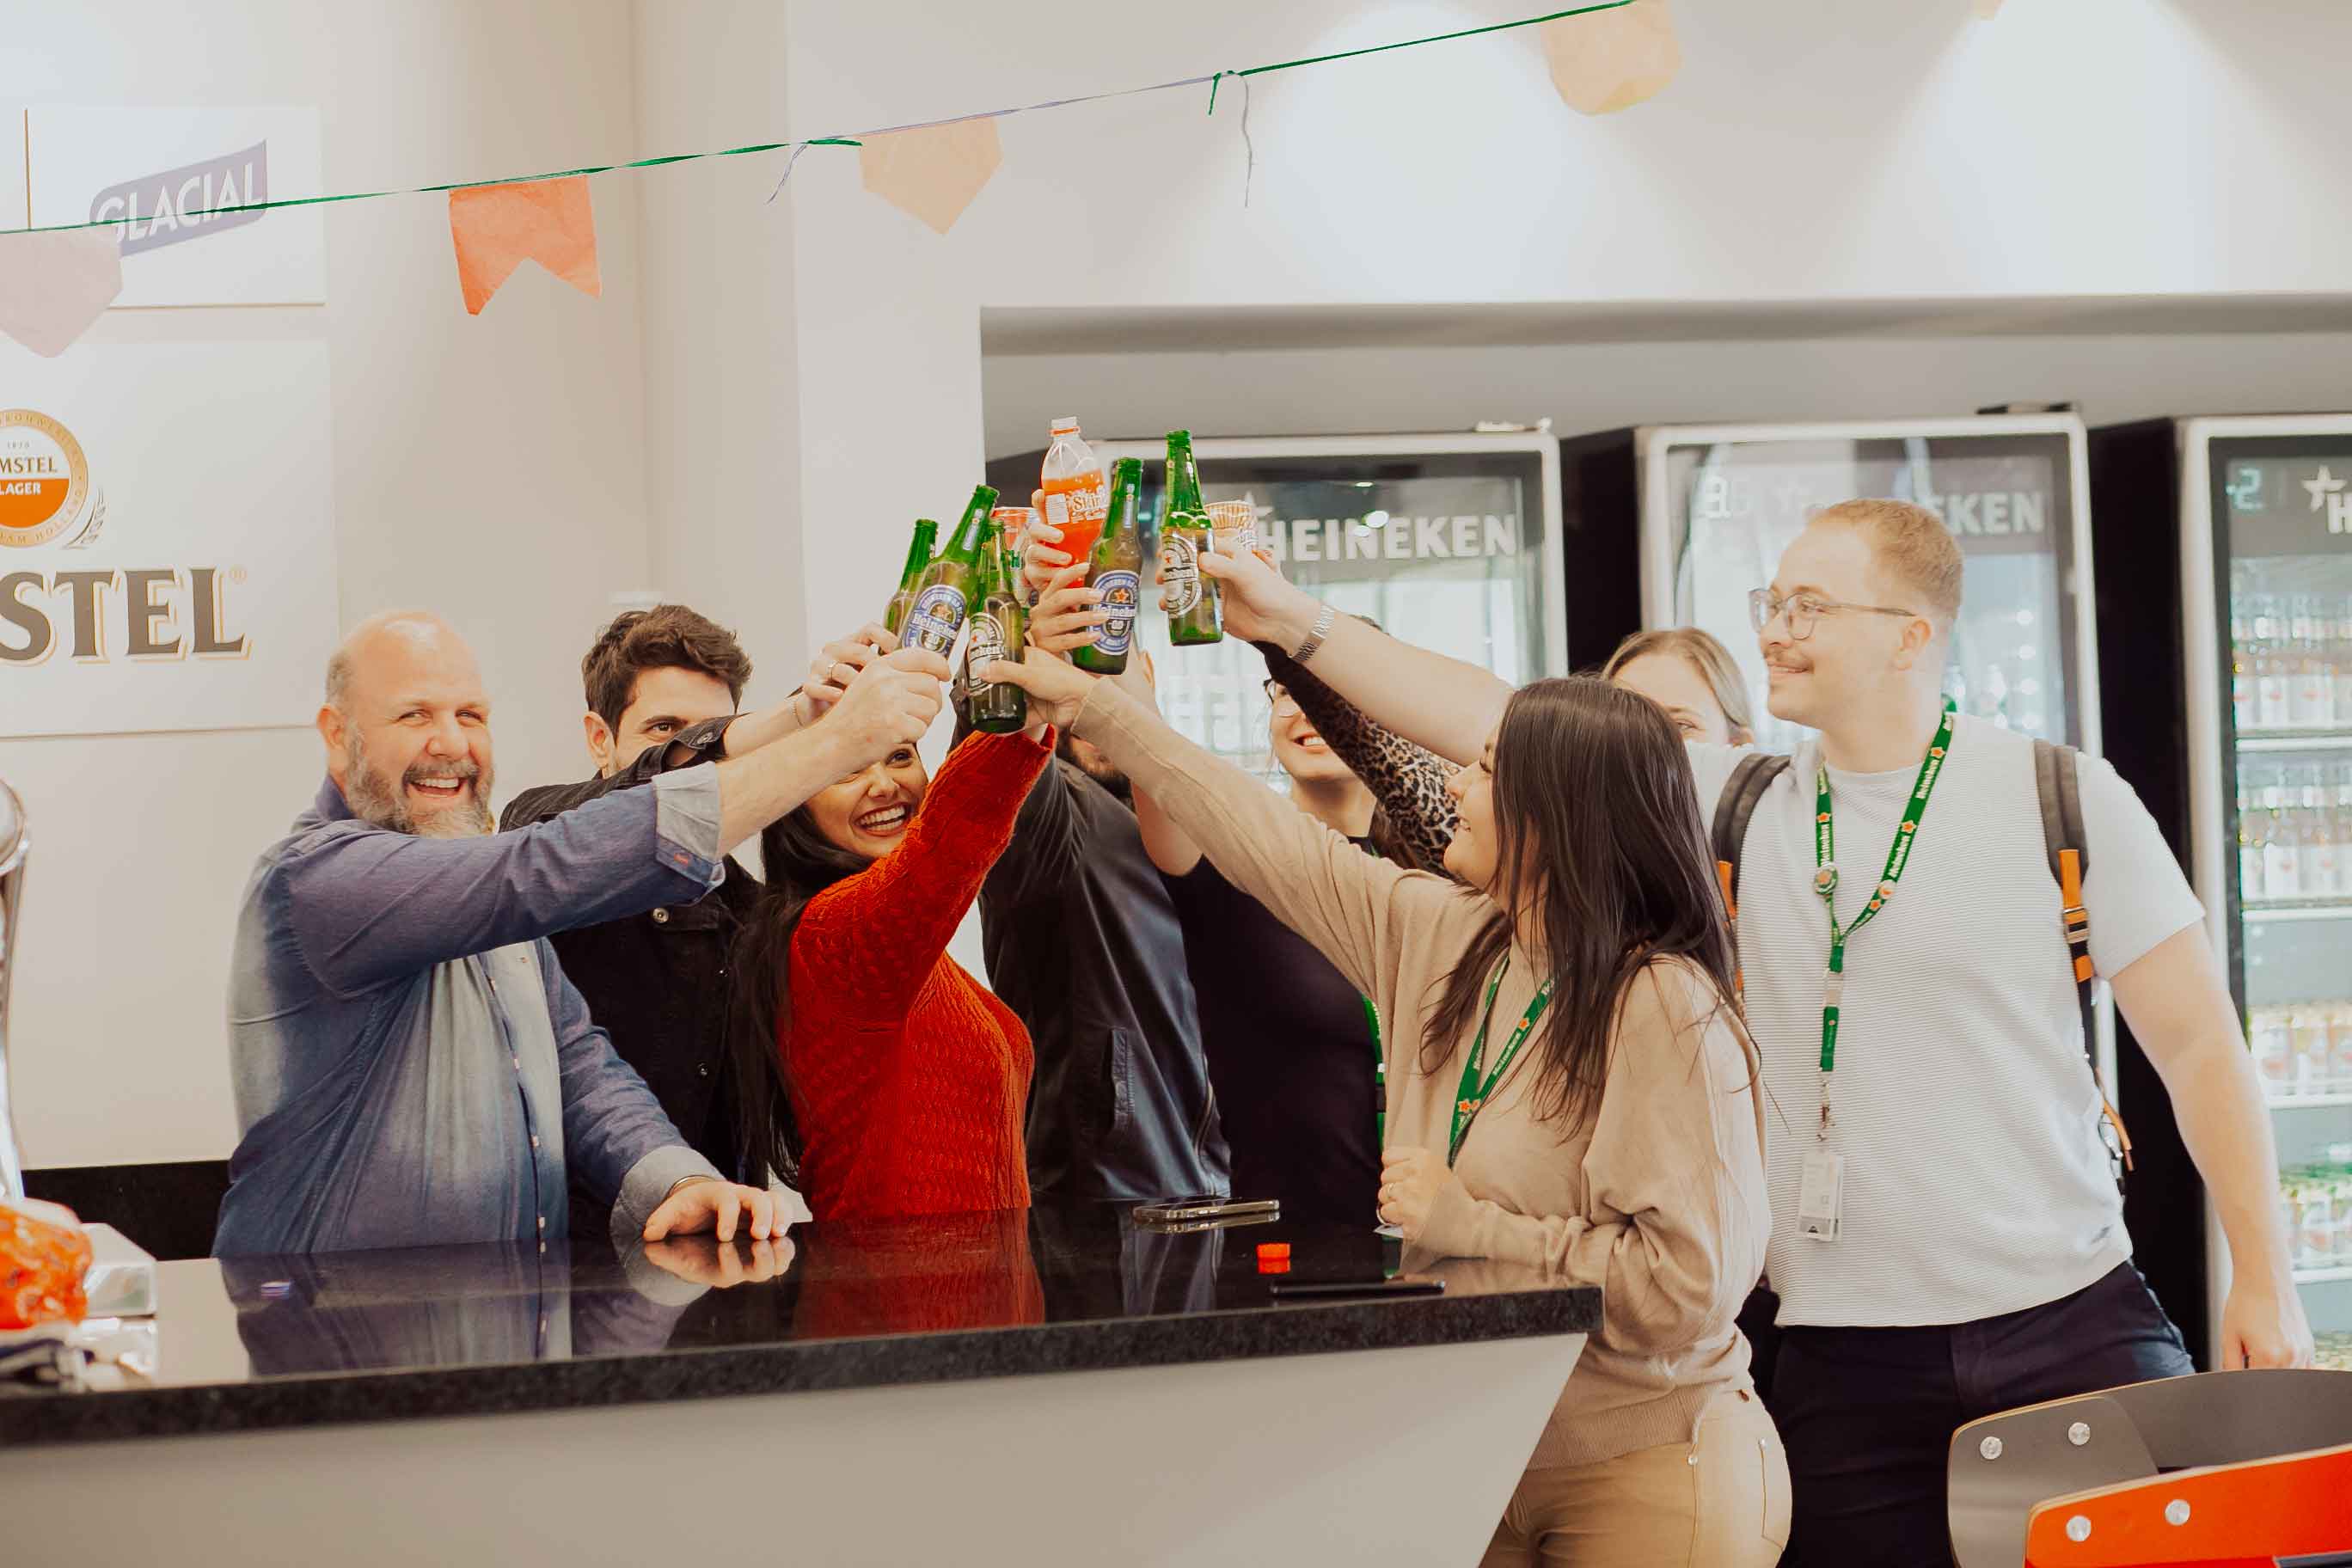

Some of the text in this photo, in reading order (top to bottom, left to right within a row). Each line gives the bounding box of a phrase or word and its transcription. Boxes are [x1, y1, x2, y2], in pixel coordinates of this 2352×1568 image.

[95, 162, 262, 243] GLACIAL
[1258, 515, 1516, 561] HEINEKEN
[0, 567, 244, 661] STEL
